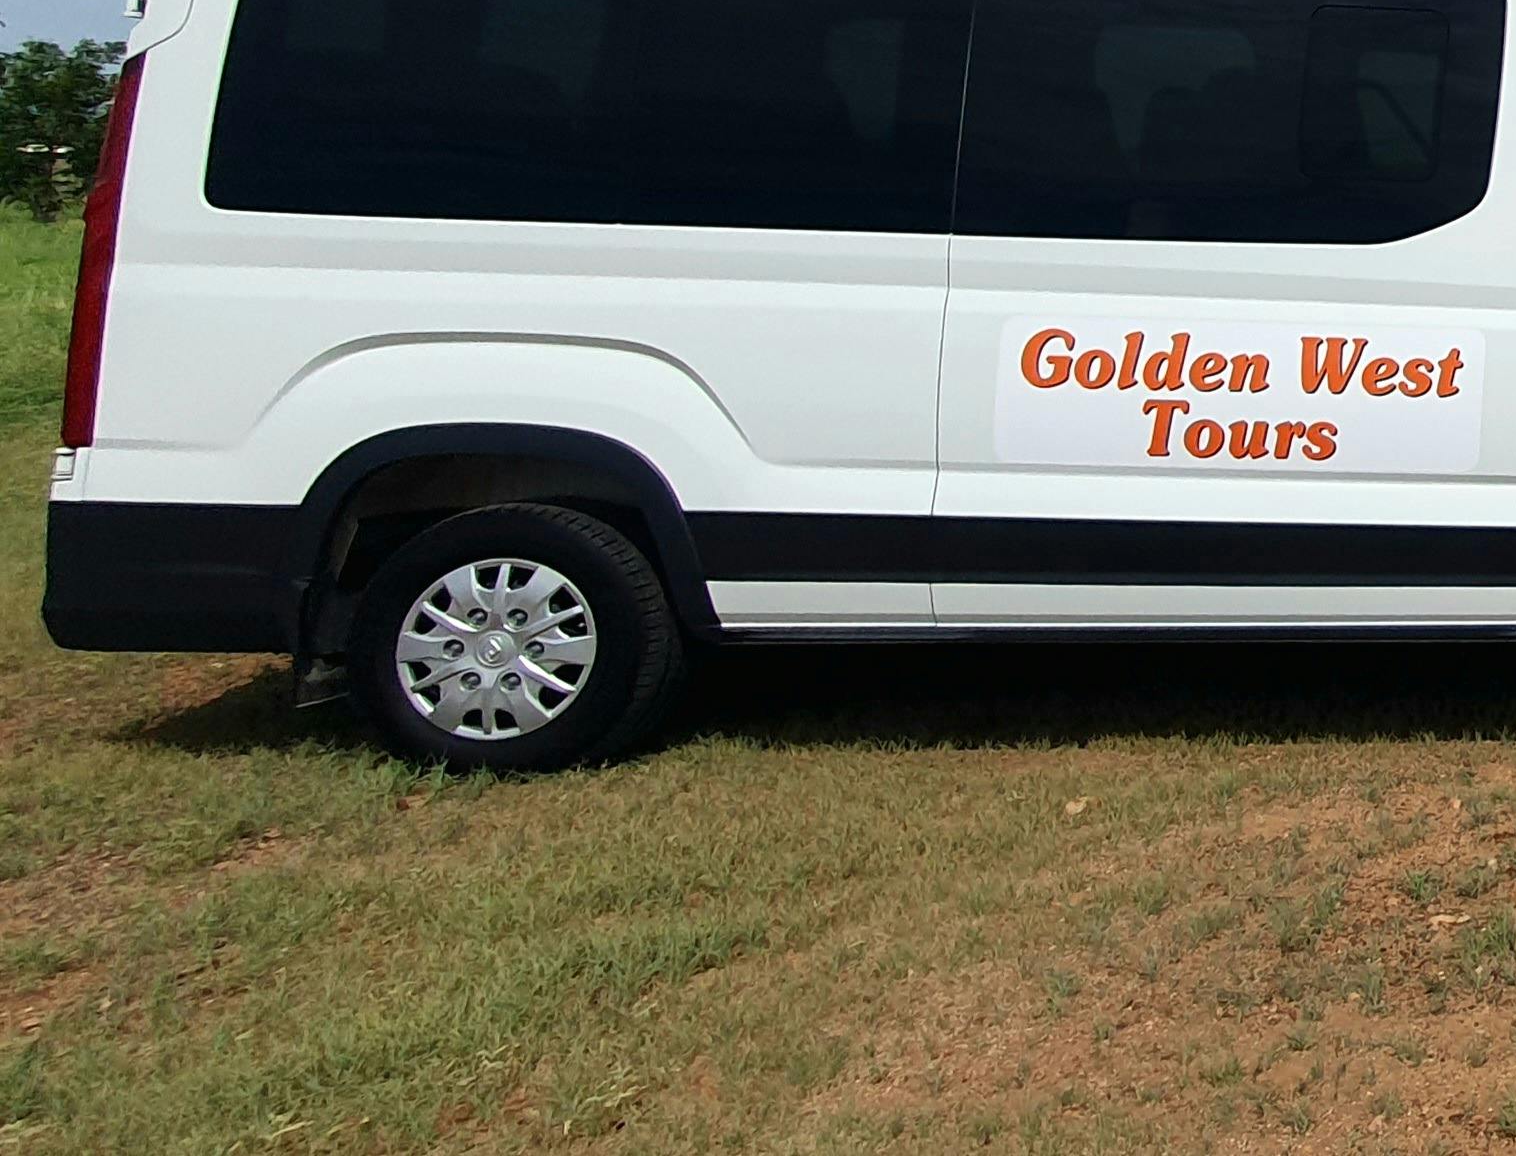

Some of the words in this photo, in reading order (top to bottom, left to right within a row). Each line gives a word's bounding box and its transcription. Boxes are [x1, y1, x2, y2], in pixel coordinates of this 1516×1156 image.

[1020, 328, 1270, 392] Golden
[1300, 337, 1465, 397] West
[1142, 399, 1338, 460] Tours
